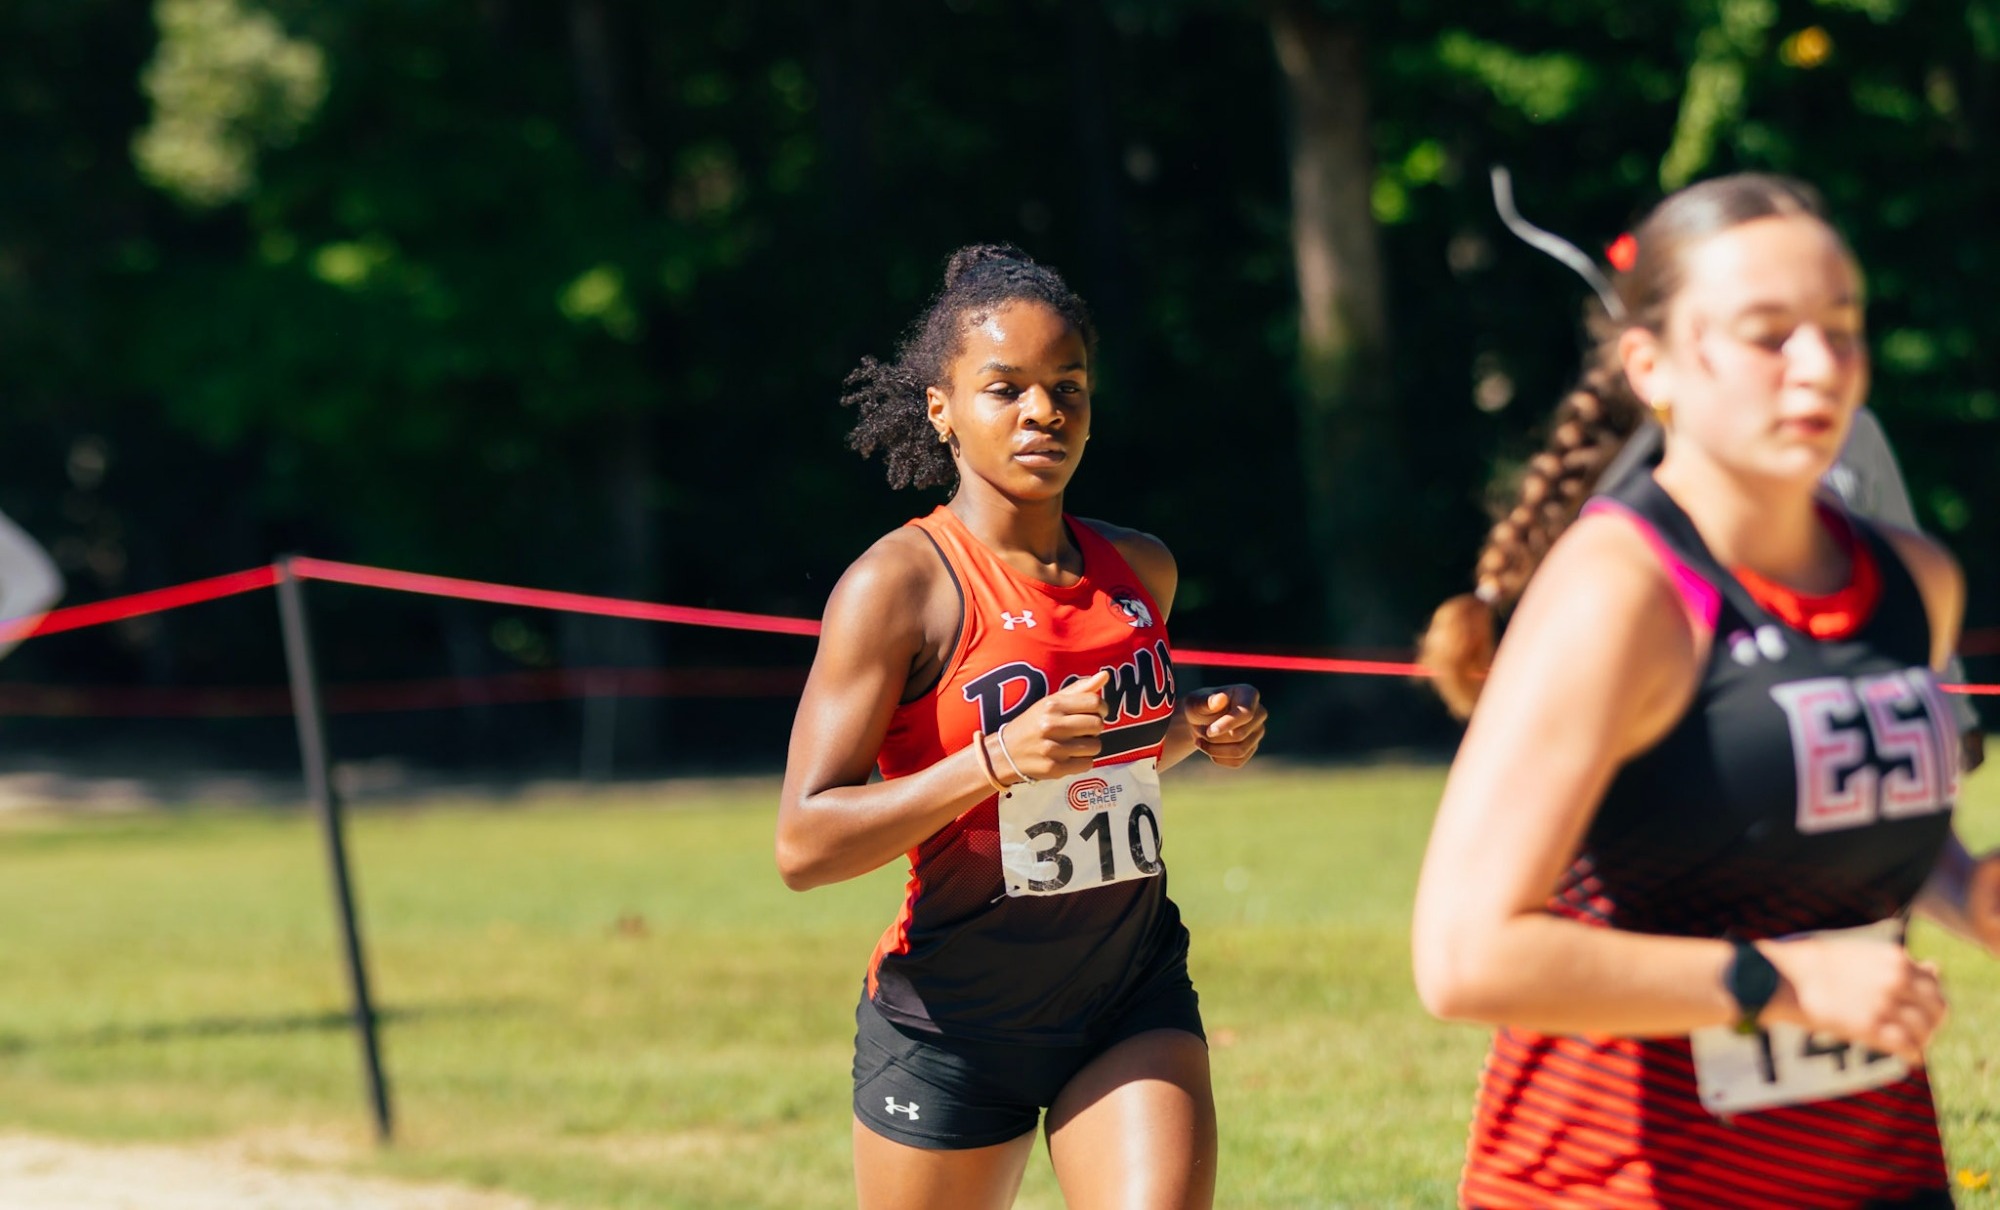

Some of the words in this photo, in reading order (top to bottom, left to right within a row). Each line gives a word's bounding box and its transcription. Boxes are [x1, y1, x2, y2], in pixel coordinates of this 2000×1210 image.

[1080, 784, 1123, 799] RHODES
[1089, 794, 1117, 805] RACE
[1025, 803, 1162, 892] 310
